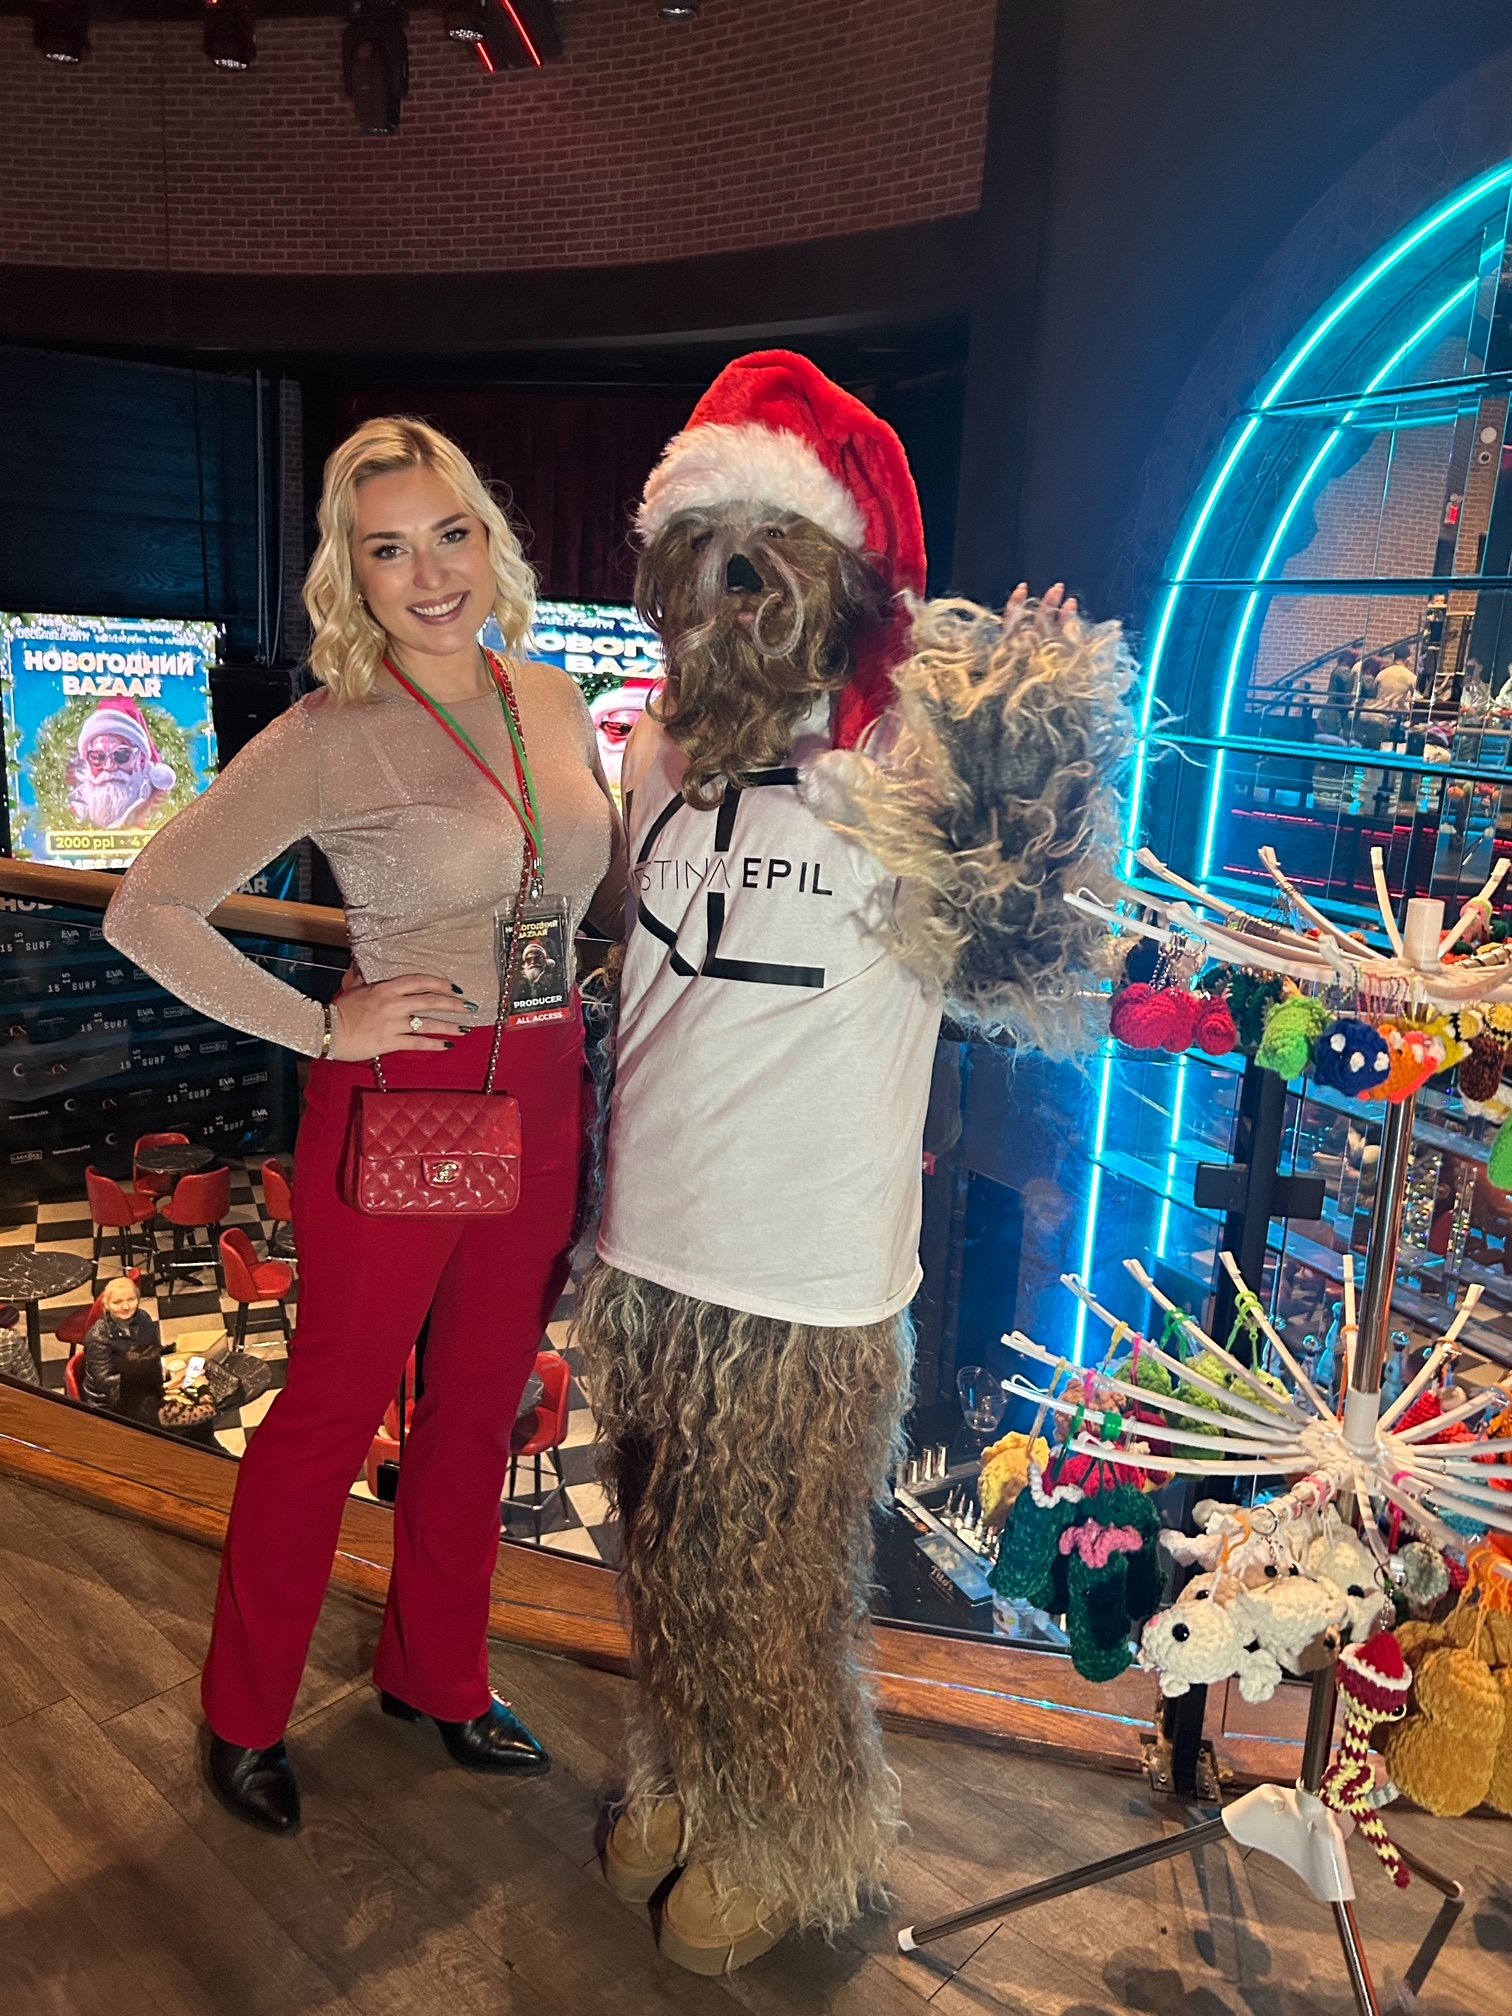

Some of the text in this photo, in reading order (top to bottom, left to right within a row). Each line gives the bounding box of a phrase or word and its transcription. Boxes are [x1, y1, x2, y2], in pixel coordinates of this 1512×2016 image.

[24, 649, 195, 677] НОВОГОДНИЙ
[62, 675, 162, 698] BAZAAR
[55, 836, 91, 849] 2000
[93, 836, 115, 850] ppl
[742, 857, 833, 896] EPIL
[61, 929, 80, 939] EVA
[25, 940, 52, 951] SURF
[106, 969, 124, 978] EVA
[48, 984, 60, 993] 15
[72, 980, 97, 991] SURF
[513, 994, 563, 1009] PRODUCER
[137, 1008, 154, 1017] EVA
[516, 1012, 563, 1025] ALL ACCESS
[80, 1023, 93, 1033] 15
[103, 1019, 128, 1030] SURF
[174, 1044, 191, 1054] EVA
[120, 1061, 132, 1070] 15
[142, 1055, 166, 1067] SURF
[218, 1077, 235, 1087] EVA
[167, 1094, 178, 1103] 15
[188, 1088, 211, 1100] SURF
[251, 1108, 268, 1118] EVA
[203, 1126, 214, 1135] 15
[224, 1120, 245, 1131] SURF
